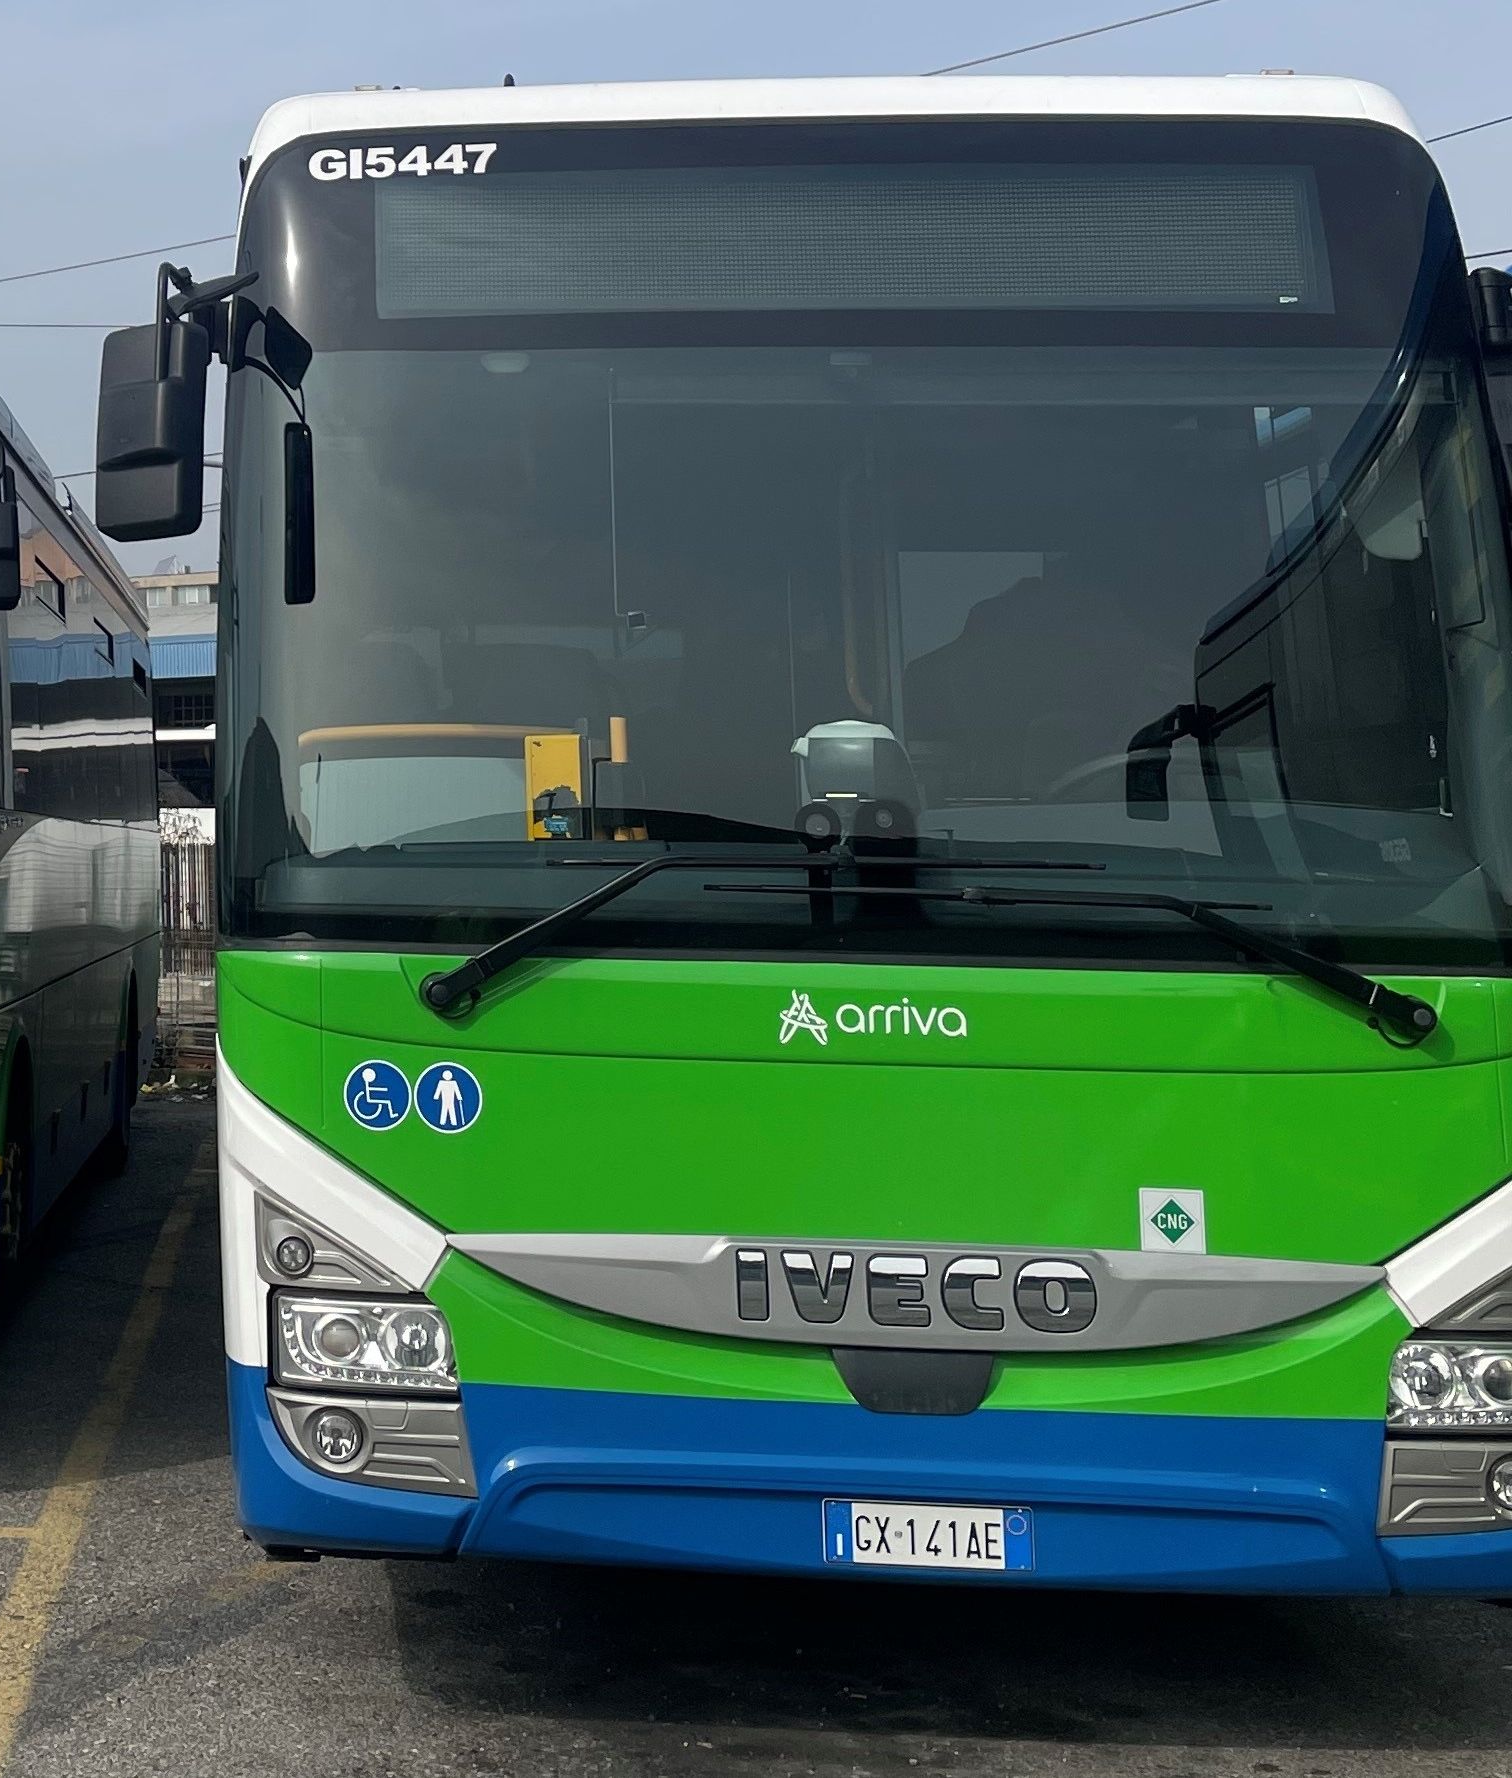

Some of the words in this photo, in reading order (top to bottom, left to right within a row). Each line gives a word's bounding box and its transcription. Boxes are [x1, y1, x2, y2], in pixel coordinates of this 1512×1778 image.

[308, 143, 497, 181] GI5447
[835, 997, 968, 1038] arriva
[1157, 1212, 1188, 1230] CNG
[736, 1248, 1098, 1334] IVECO
